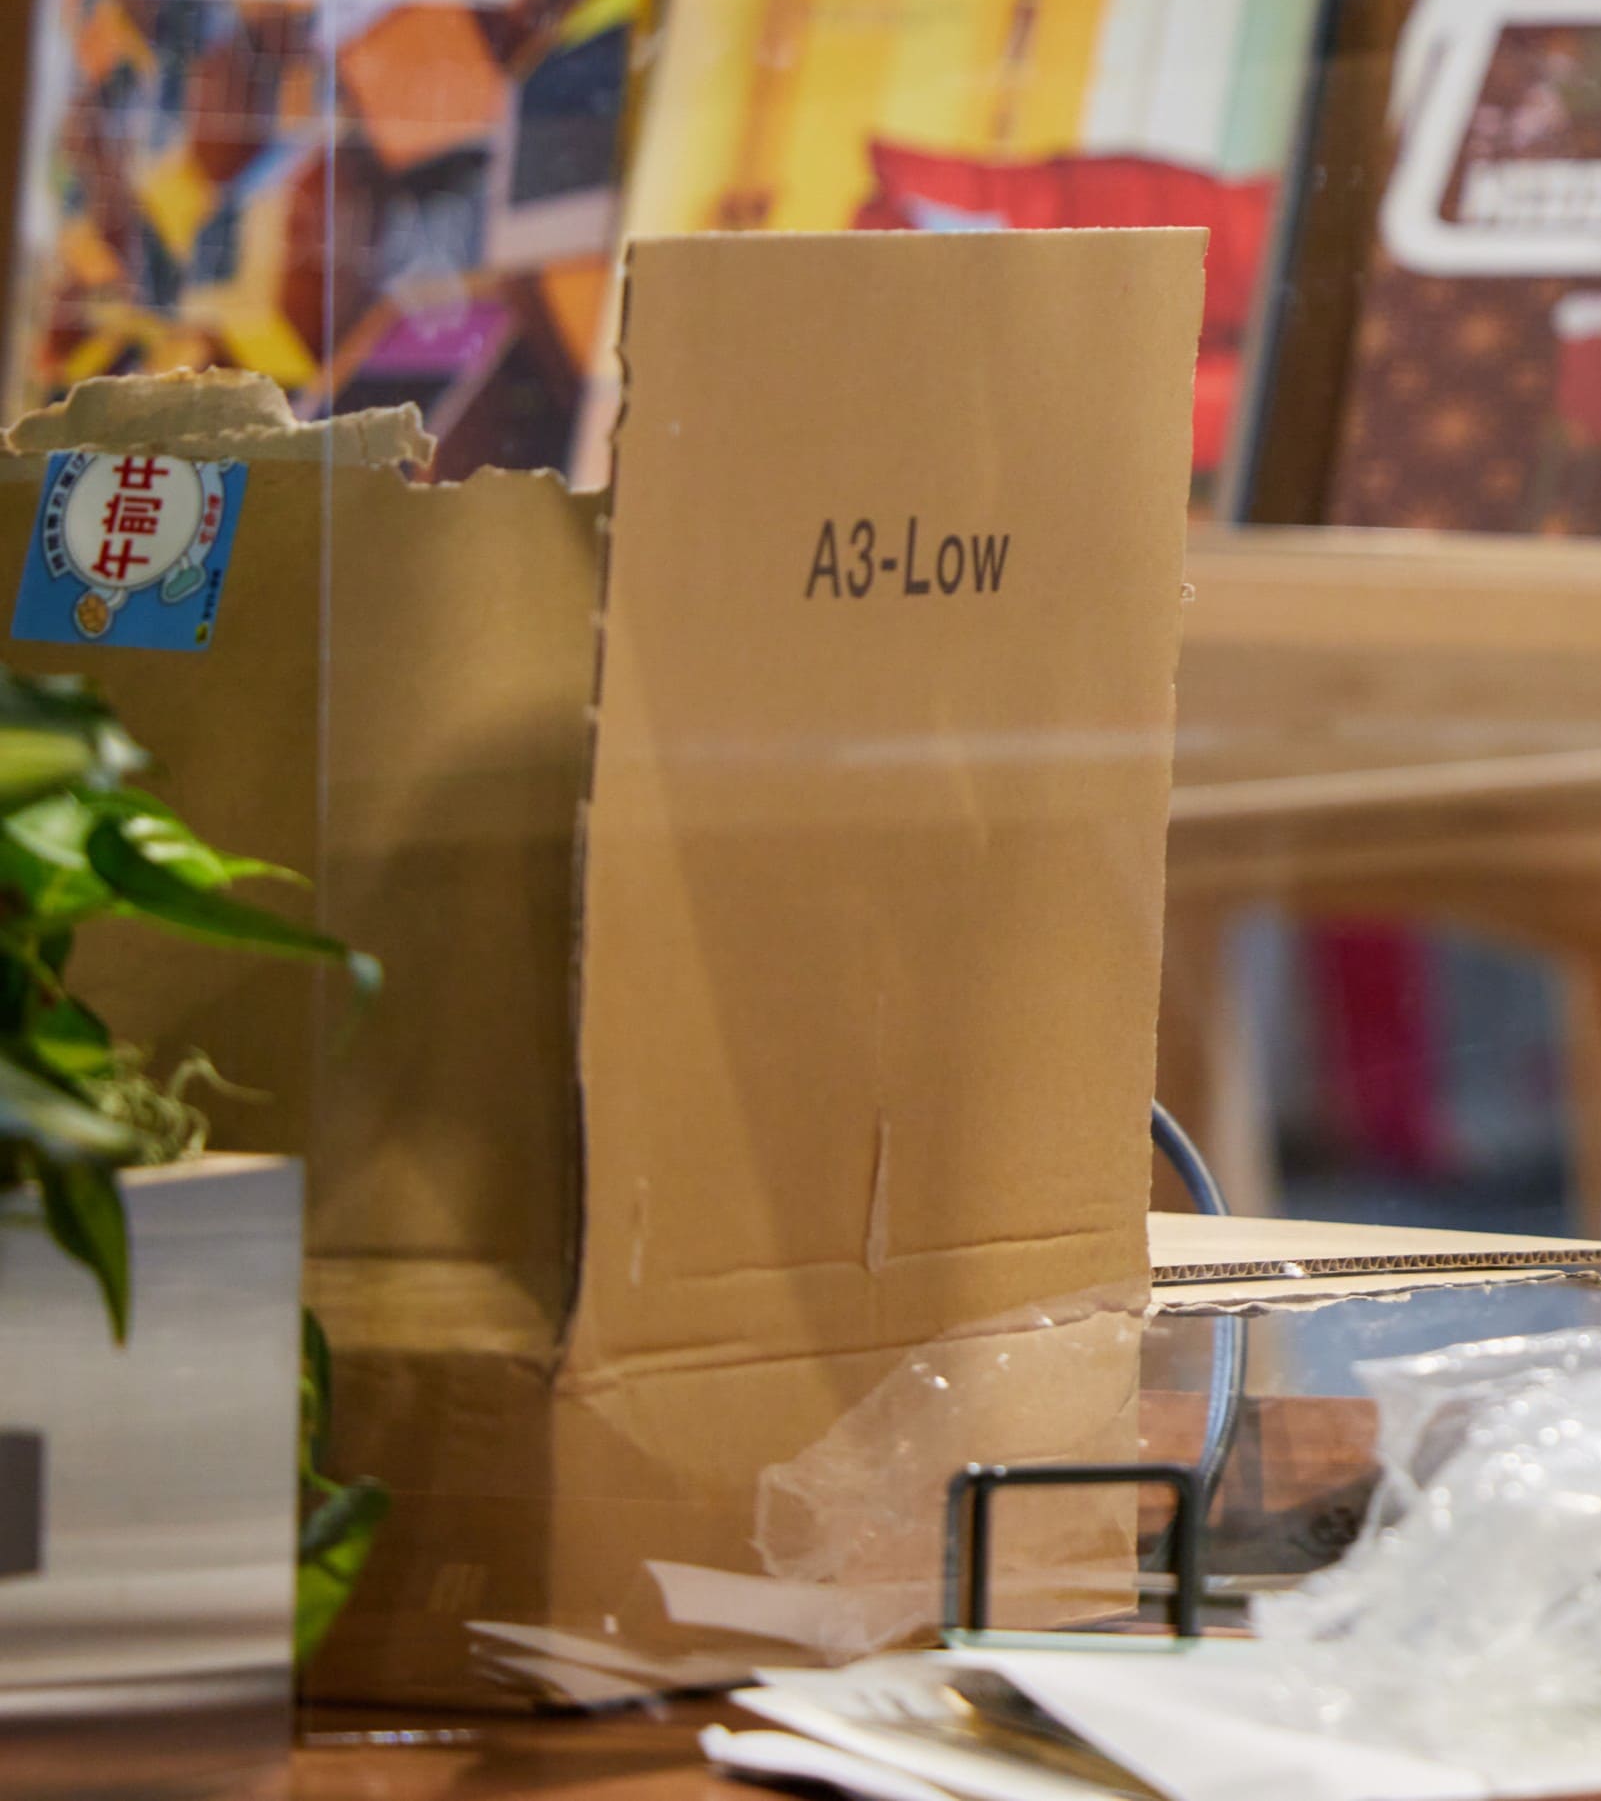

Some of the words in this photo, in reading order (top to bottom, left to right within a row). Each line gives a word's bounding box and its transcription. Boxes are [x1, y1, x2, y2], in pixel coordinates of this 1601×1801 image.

[90, 455, 171, 582] 午前中
[804, 515, 1011, 600] A3-Low
